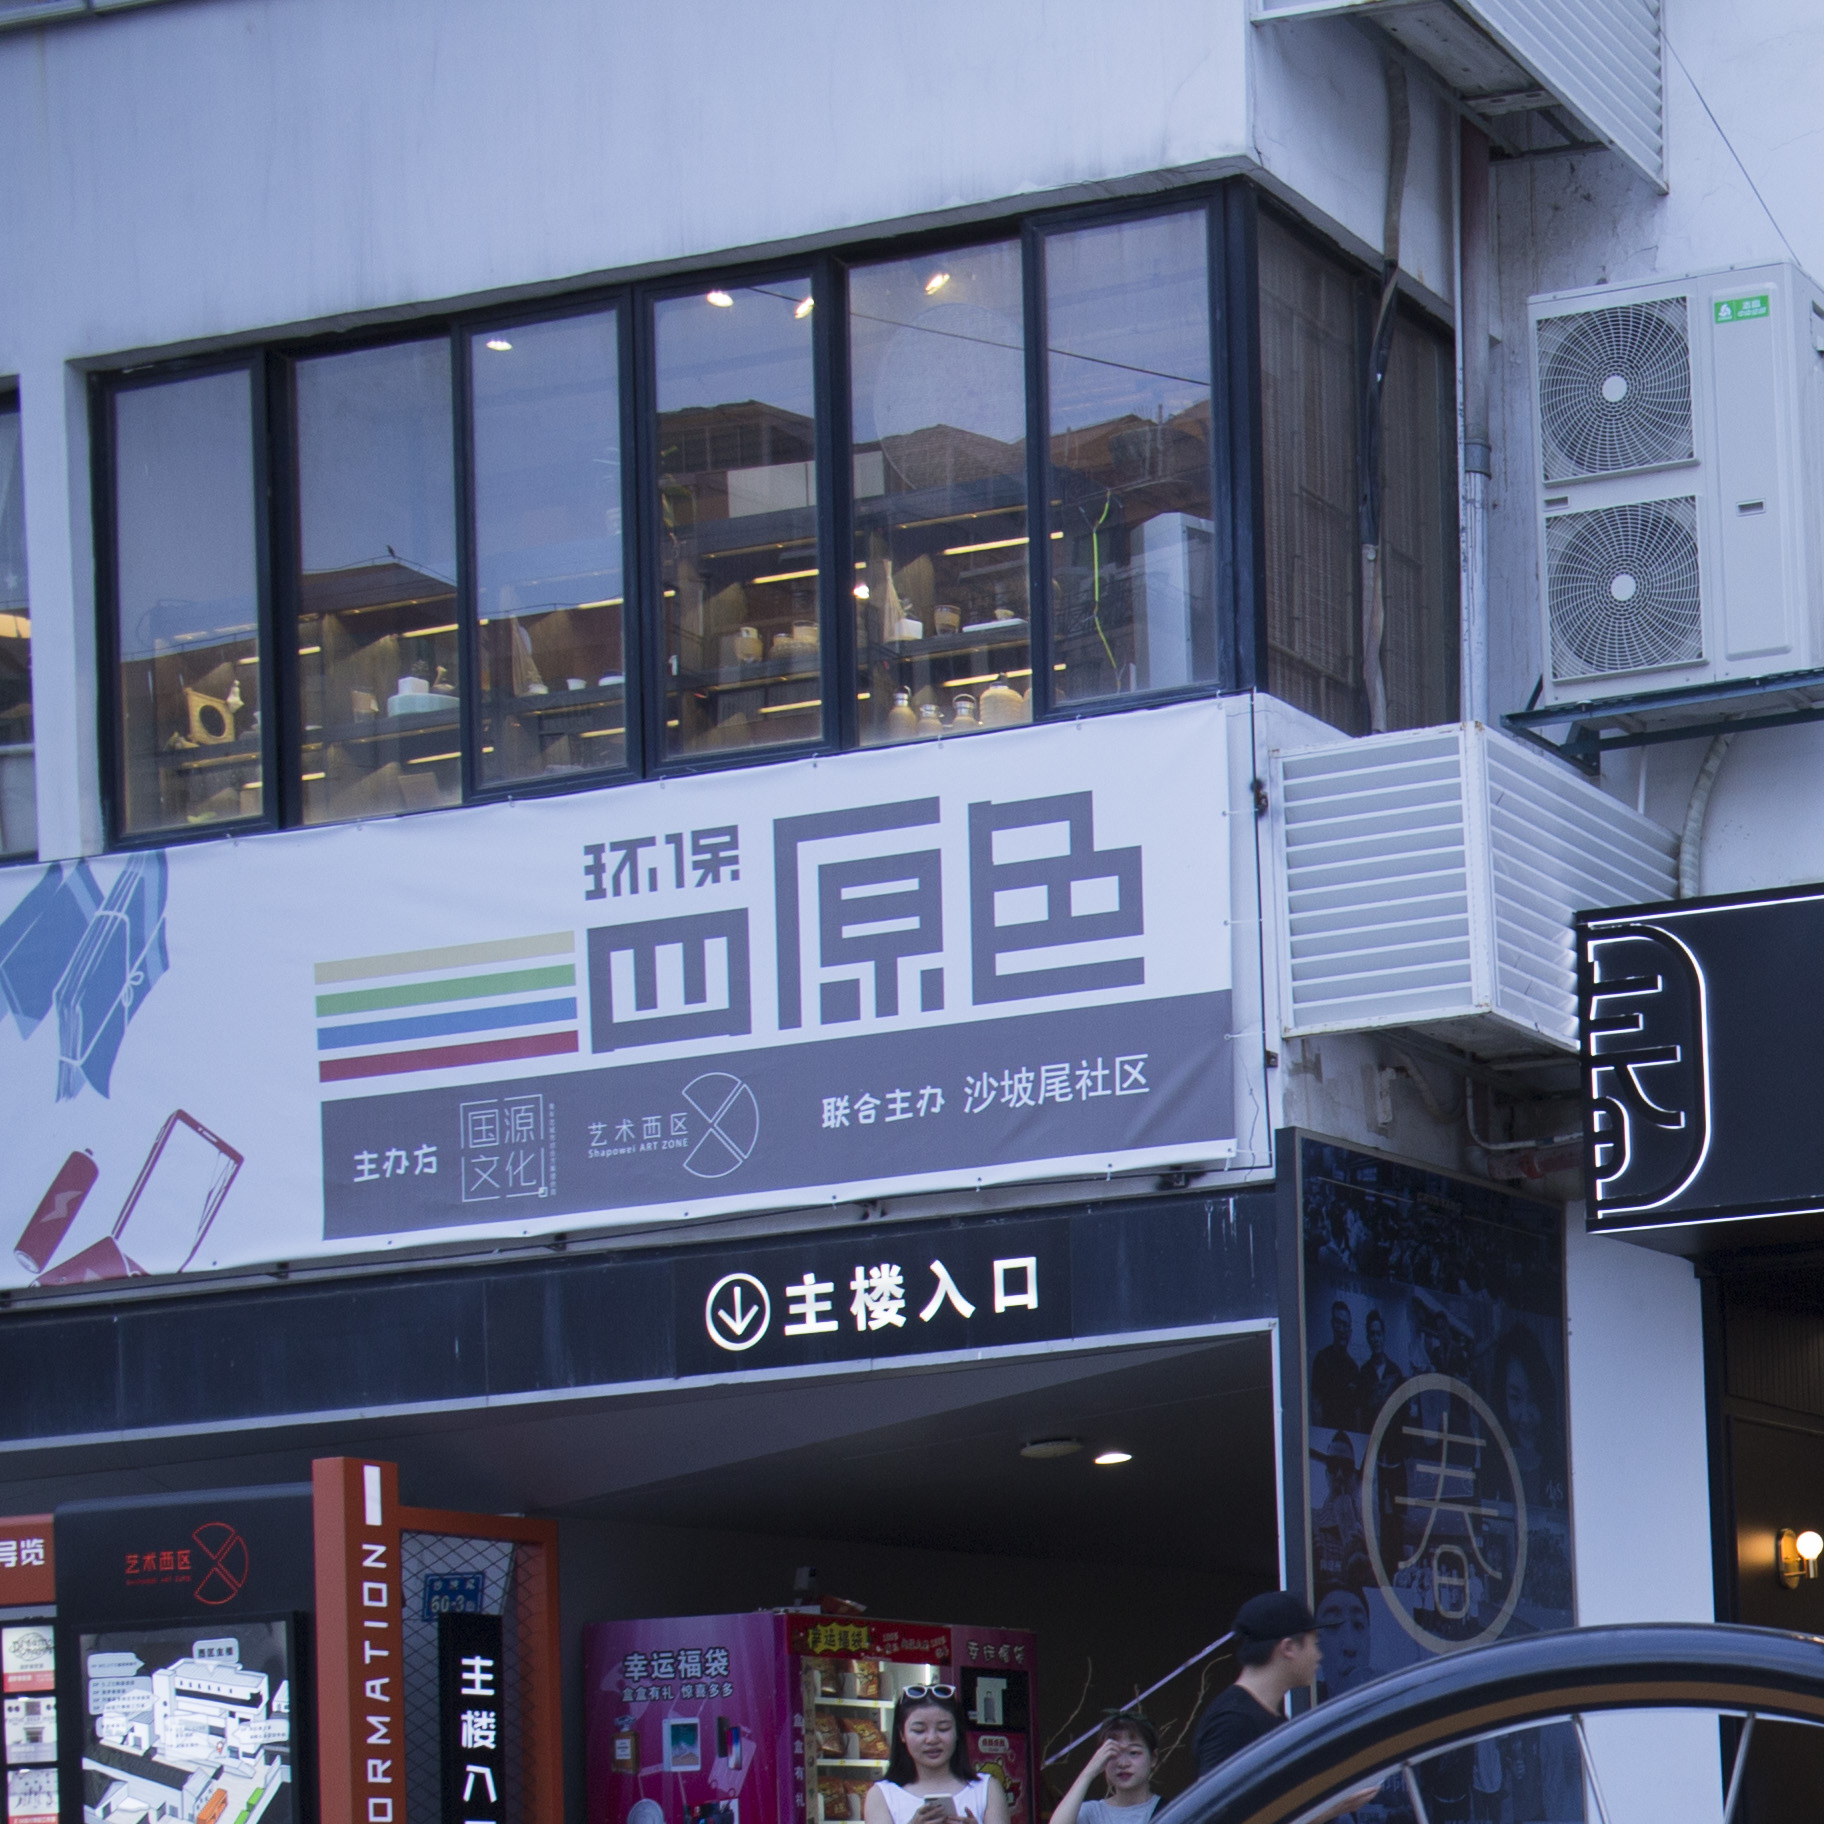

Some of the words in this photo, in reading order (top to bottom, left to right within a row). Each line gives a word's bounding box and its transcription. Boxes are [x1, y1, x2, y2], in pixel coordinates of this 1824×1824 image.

[584, 826, 741, 901] 环保
[821, 1084, 946, 1132] 联合主办
[963, 1053, 1151, 1116] 沙坡尾社区
[468, 1104, 536, 1149] 国源
[587, 1112, 689, 1147] 艺术西区
[353, 1143, 438, 1183] 主办方
[588, 1144, 637, 1159] Shapowei
[640, 1141, 659, 1152] ART
[662, 1137, 690, 1151] ZONE
[470, 1150, 538, 1193] 文化
[785, 1255, 1041, 1337] 主楼入口
[1394, 1410, 1504, 1620] 春
[125, 1549, 193, 1575] 艺术西区
[622, 1646, 731, 1681] 幸运福袋
[622, 1685, 675, 1702] 盒盒有礼
[680, 1682, 735, 1700] 惊喜多多
